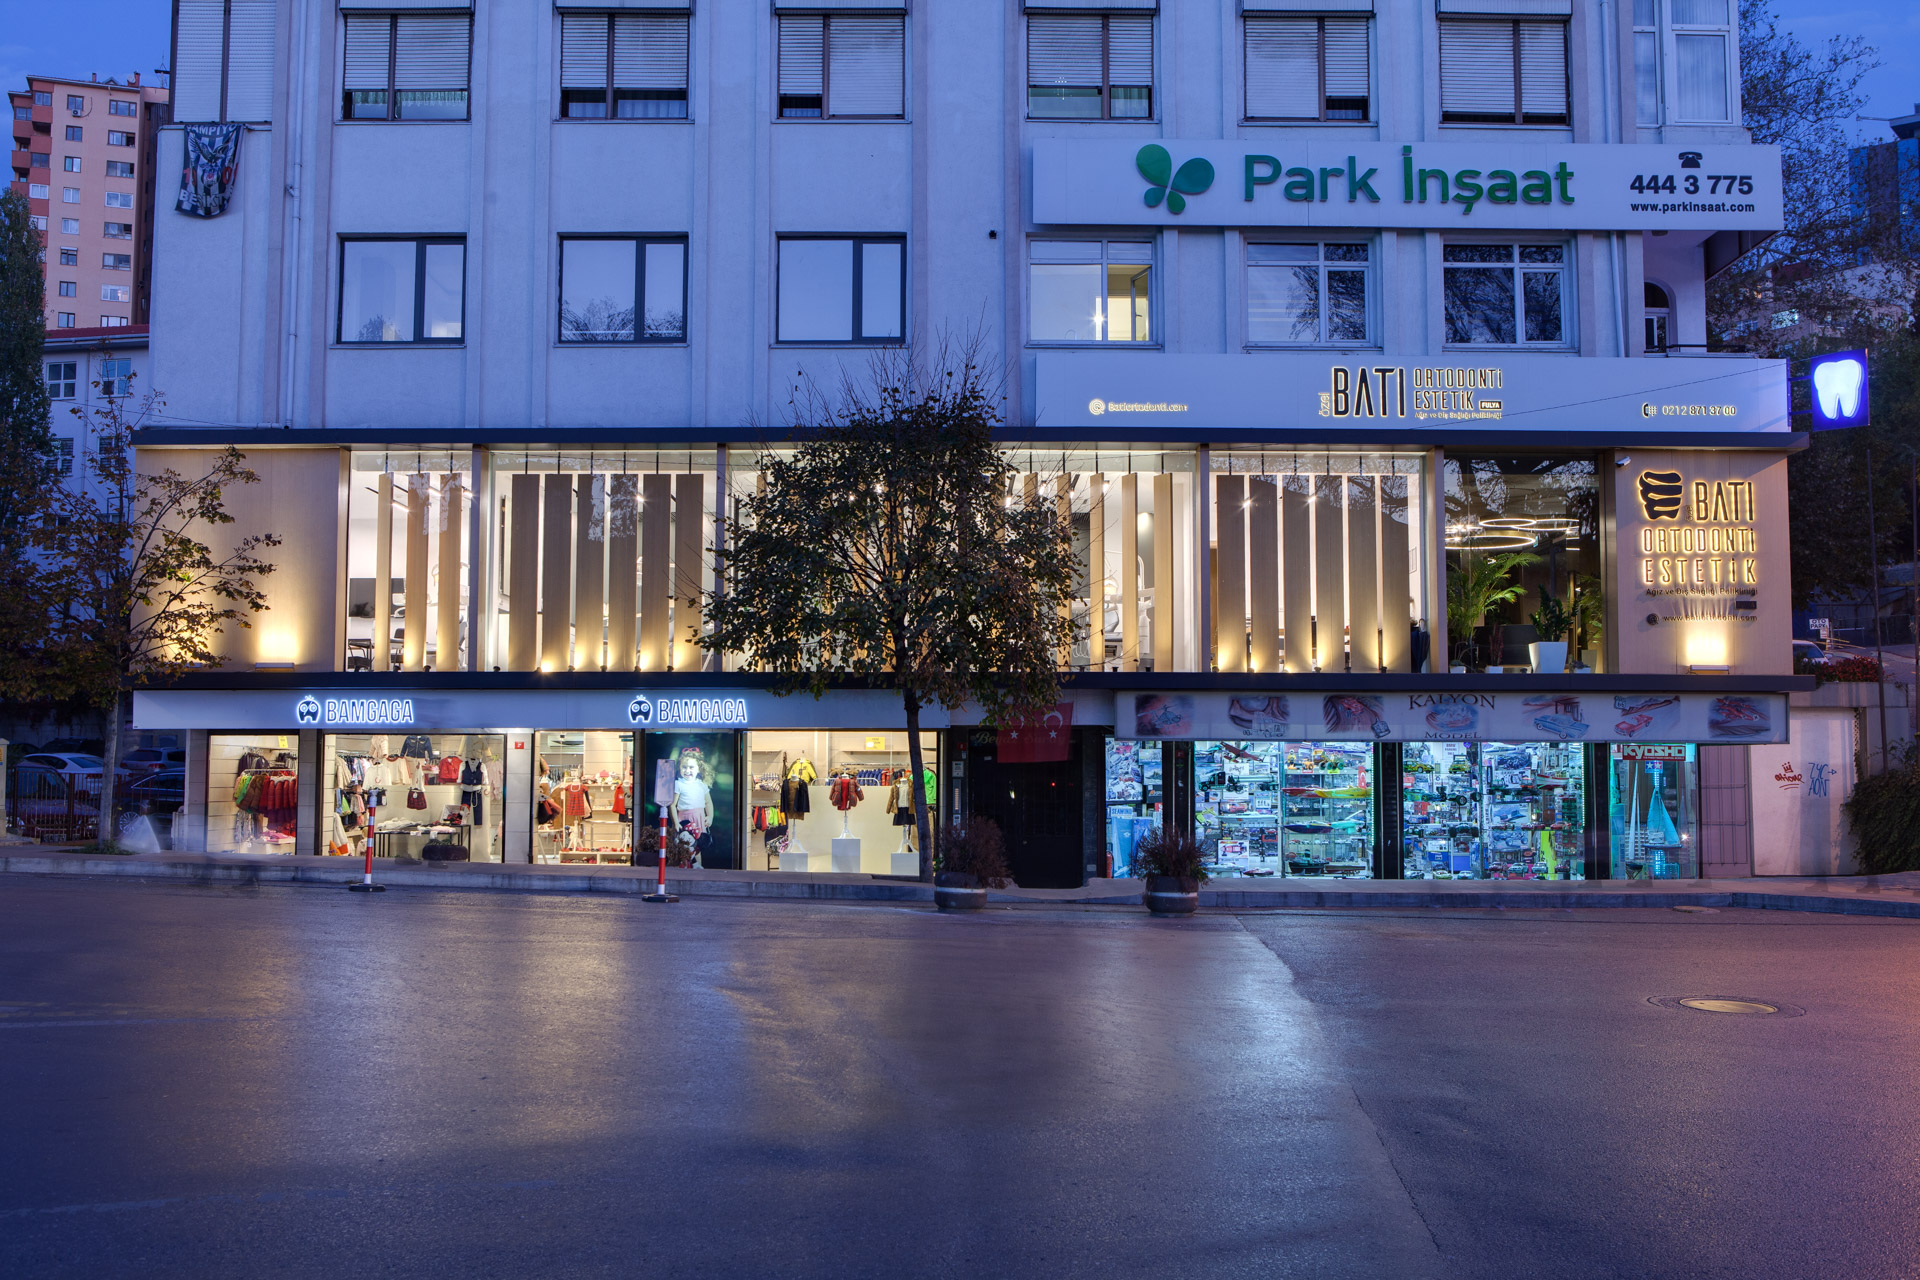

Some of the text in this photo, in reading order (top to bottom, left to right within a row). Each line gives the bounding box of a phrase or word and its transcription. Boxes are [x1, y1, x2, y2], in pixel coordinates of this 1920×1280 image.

[1244, 144, 1576, 215] Park İnşaat
[1630, 174, 1754, 195] 444 3 775
[1630, 201, 1755, 214] www.parkinsaat.com
[1332, 366, 1406, 418] BATI
[1480, 401, 1501, 409] FULYA
[1662, 405, 1736, 416] 0212 871 37 00
[1694, 481, 1755, 522] BATI
[326, 699, 414, 723] BAMGAGA
[657, 699, 748, 723] BAMGAGA
[1408, 693, 1496, 710] KALYON
[1424, 731, 1482, 739] MODEL
[1623, 745, 1685, 759] KYOSHO
